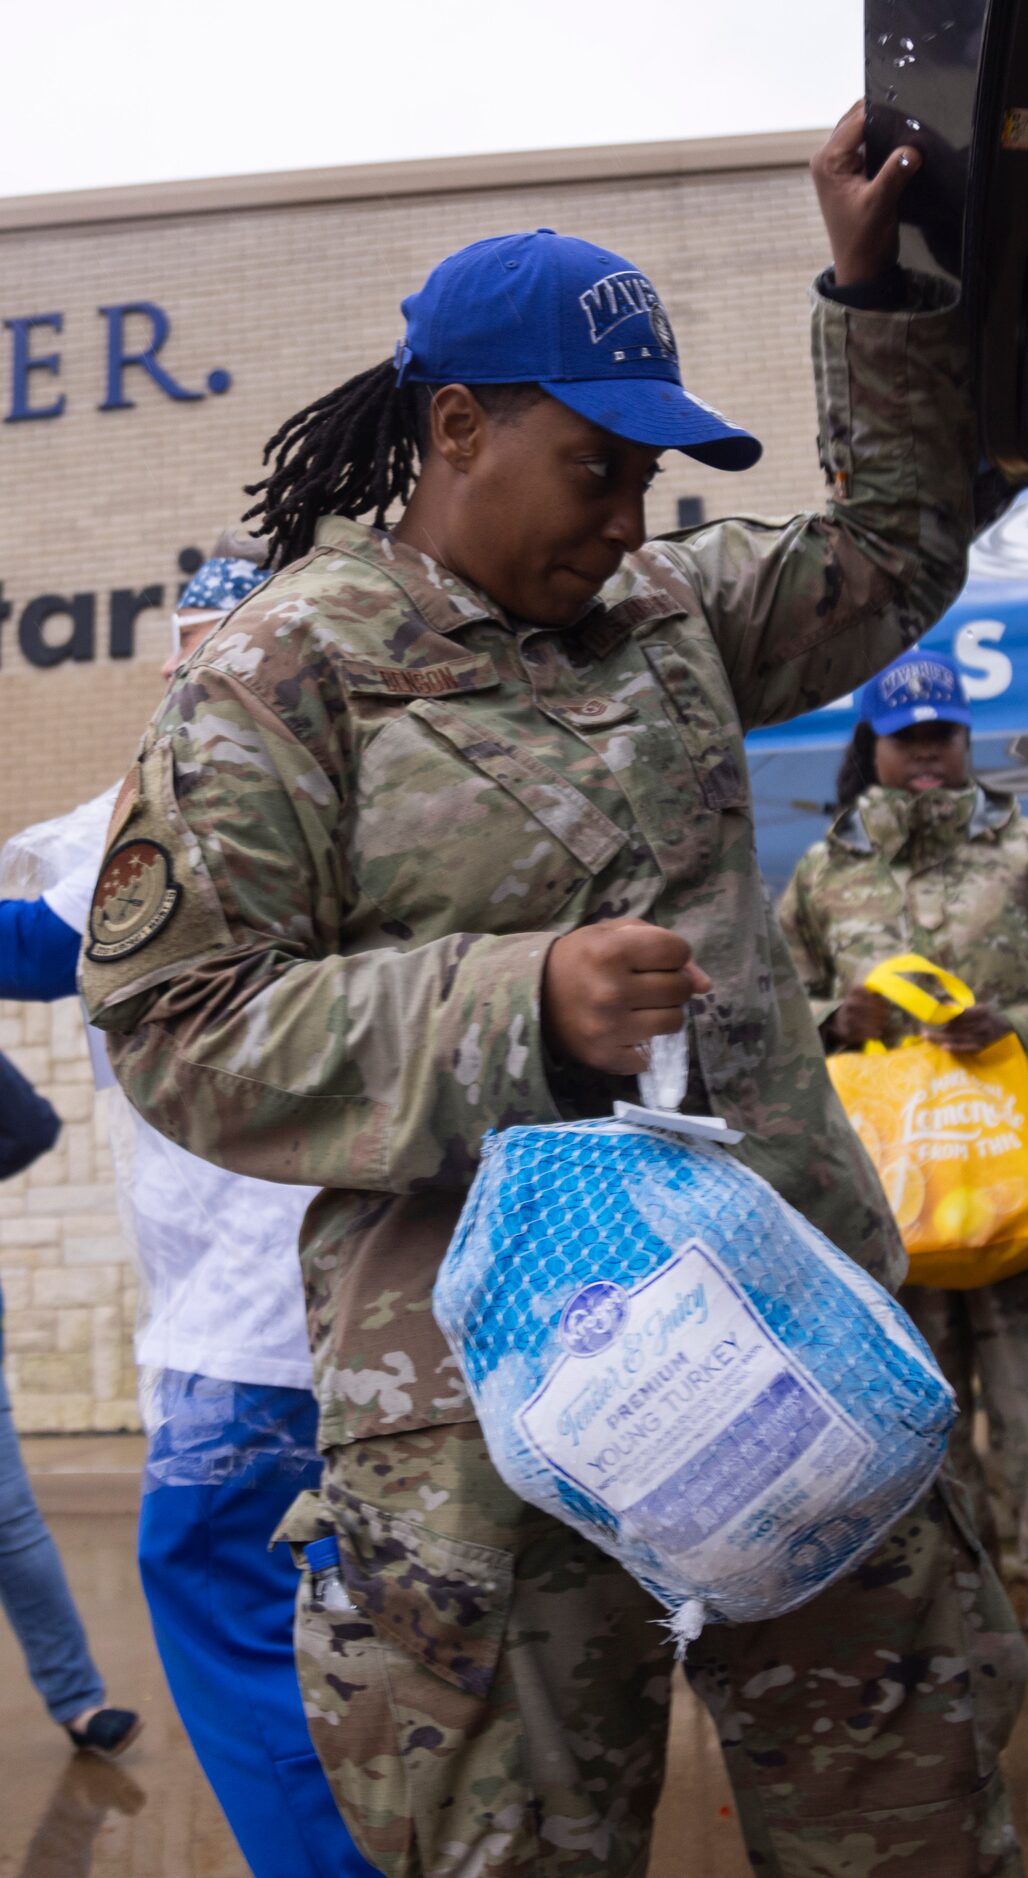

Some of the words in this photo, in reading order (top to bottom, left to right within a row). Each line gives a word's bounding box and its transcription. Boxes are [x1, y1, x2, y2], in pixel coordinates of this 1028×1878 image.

[587, 1412, 662, 1474] YOUNG
[658, 1331, 741, 1411] TURKEY
[606, 1351, 691, 1430] PREMIUM
